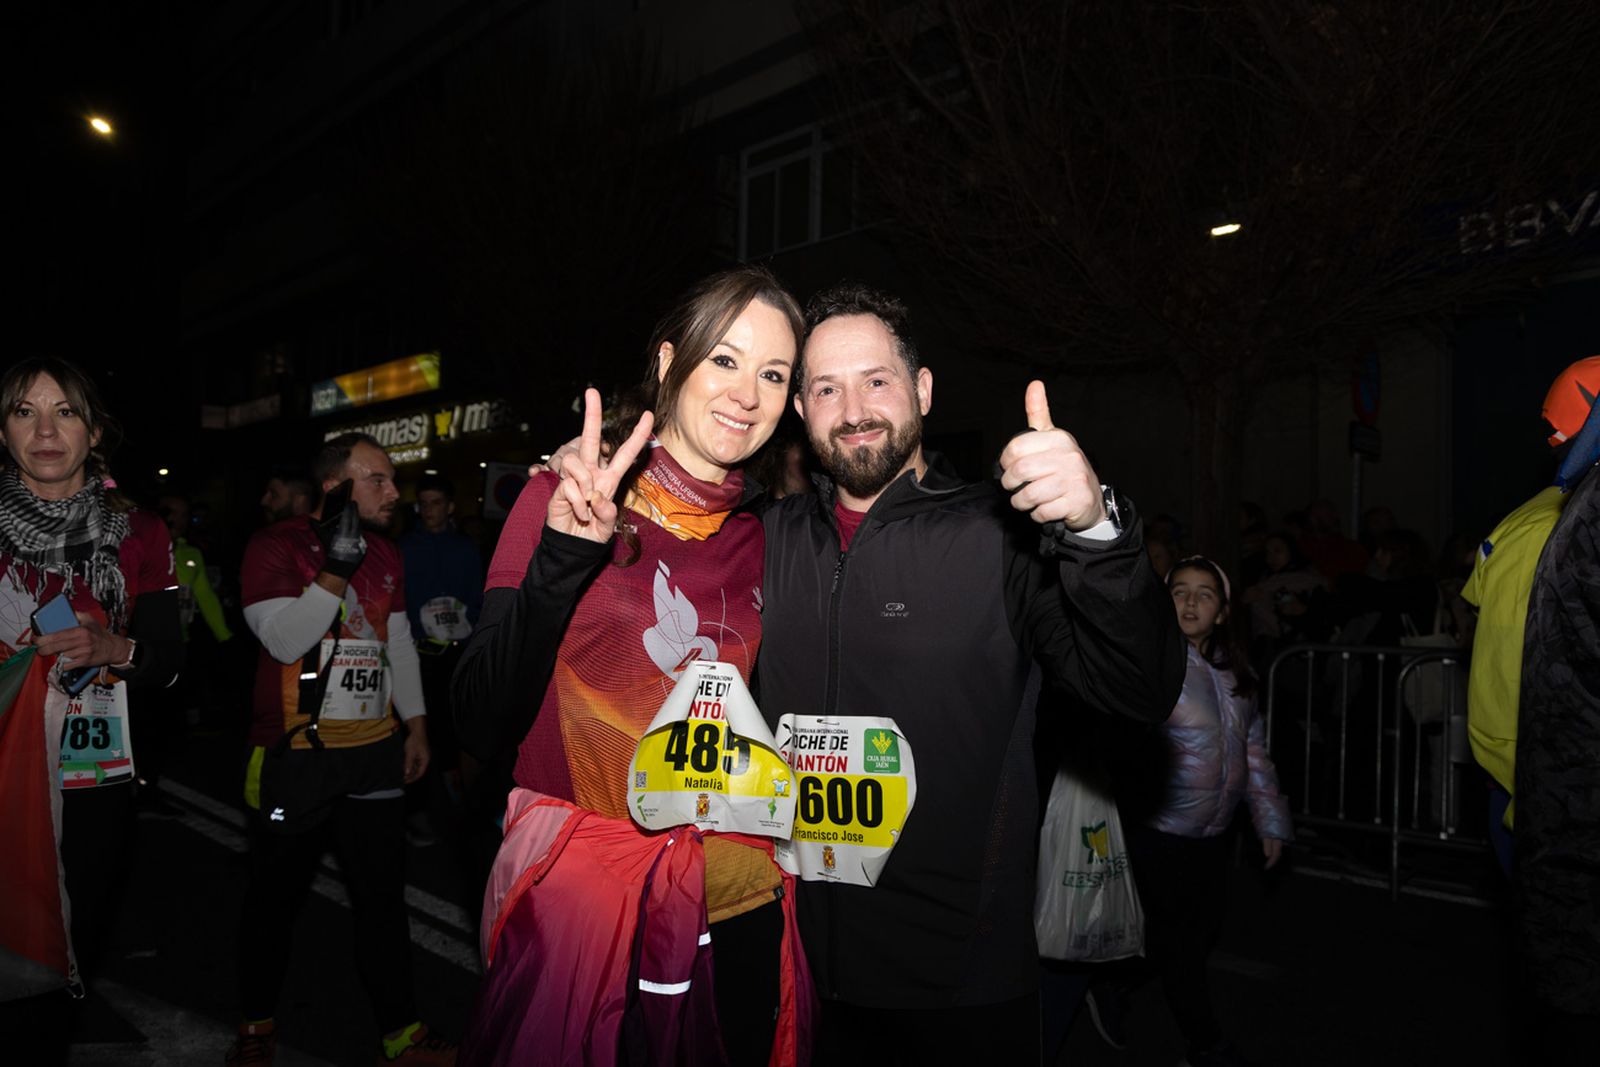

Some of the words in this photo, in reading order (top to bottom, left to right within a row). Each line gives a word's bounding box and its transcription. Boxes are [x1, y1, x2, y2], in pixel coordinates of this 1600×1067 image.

[1459, 190, 1600, 254] BBV
[680, 484, 707, 508] URBANA
[690, 697, 727, 721] NTÓ
[664, 720, 751, 776] 485
[792, 734, 827, 750] OCHE
[829, 735, 849, 751] DE
[796, 751, 849, 773] ANTÓN
[684, 777, 723, 790] Natalia
[794, 775, 883, 829] 600
[795, 826, 839, 841] Francisco
[841, 830, 864, 843] Jose
